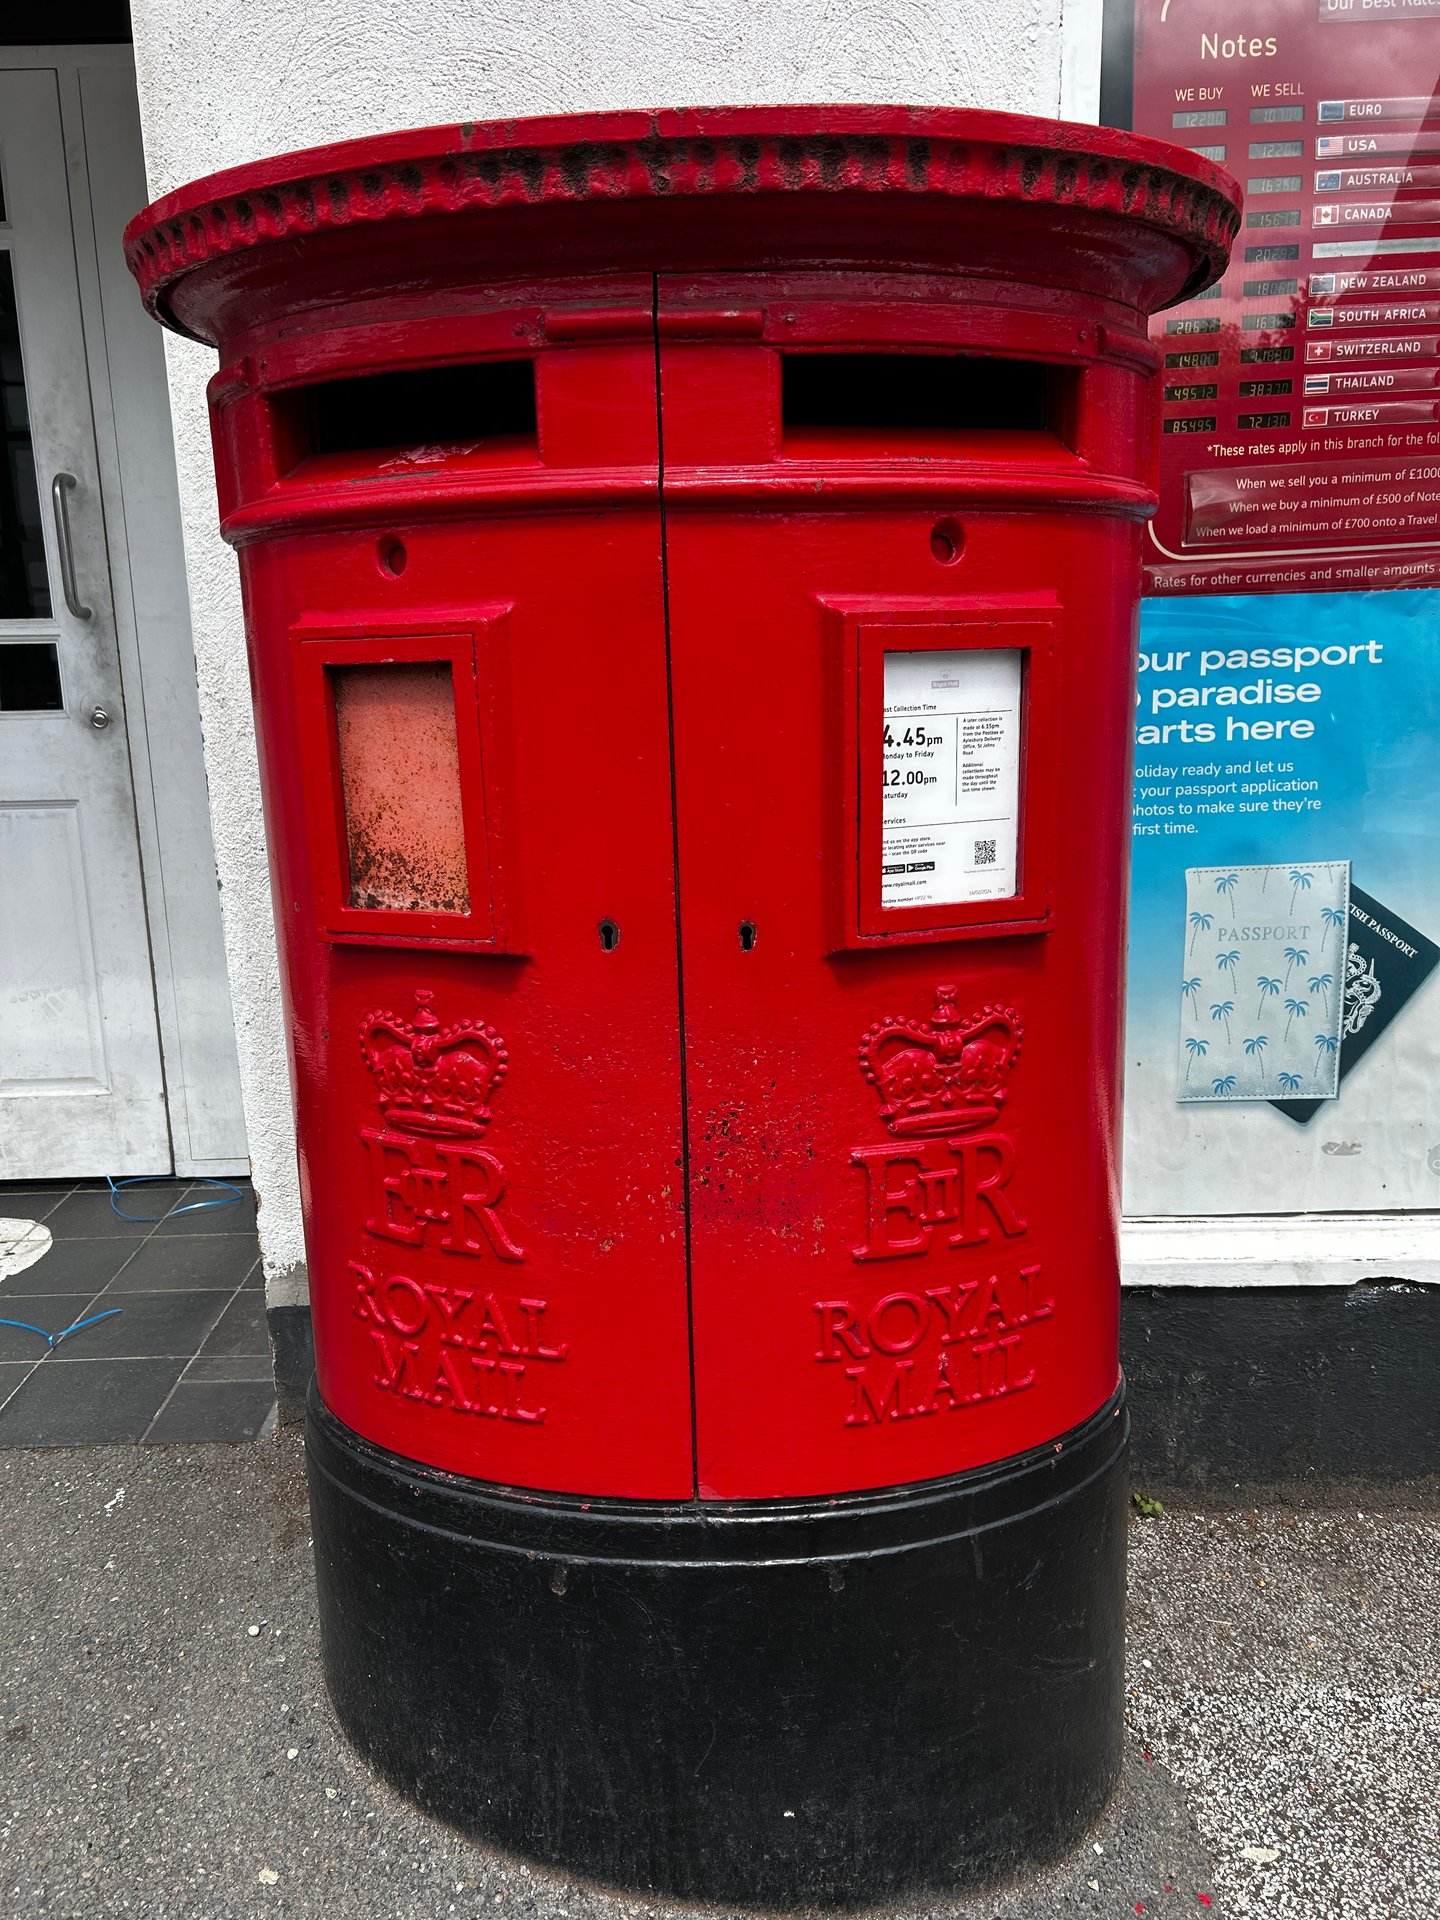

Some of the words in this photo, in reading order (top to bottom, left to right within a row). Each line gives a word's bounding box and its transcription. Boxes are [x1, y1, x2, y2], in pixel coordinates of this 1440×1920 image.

[1200, 33, 1278, 60] Notes
[1174, 88, 1195, 102] WE
[1199, 86, 1224, 100] BUY
[1250, 84, 1271, 97] WE
[1274, 82, 1305, 96] SELL
[1349, 103, 1382, 116] EURO
[1348, 139, 1378, 151] USA
[1346, 172, 1414, 186] AUSTRALIA
[1344, 207, 1393, 220] CANADA
[1340, 277, 1368, 289] NEW
[1372, 274, 1427, 288] ZEALAND
[1338, 310, 1380, 323] SOUTH
[1384, 308, 1427, 321] AFRICA
[1336, 341, 1421, 356] SWITZERLAND
[1335, 375, 1395, 389] THAILAND
[1334, 409, 1380, 422] TURKEY
[1248, 443, 1275, 455] rates
[1278, 440, 1307, 455] apply
[1310, 438, 1320, 451] in
[1324, 438, 1344, 450] this
[1347, 435, 1384, 449] branch
[1387, 434, 1403, 446] for
[1405, 433, 1424, 445] the
[1236, 478, 1266, 490] When
[1269, 478, 1285, 488] we
[1288, 475, 1306, 487] sell
[1308, 476, 1328, 488] you
[1331, 475, 1338, 484] a
[1341, 472, 1392, 483] minimum
[1395, 469, 1407, 480] of
[1229, 501, 1259, 513] When
[1262, 502, 1277, 511] we
[1280, 500, 1299, 512] buy
[1301, 500, 1308, 509] a
[1310, 497, 1360, 508] minimum
[1362, 494, 1374, 505] of
[1376, 493, 1401, 505] £500
[1403, 492, 1415, 503] of
[1196, 526, 1226, 537] When
[1228, 527, 1244, 535] we
[1246, 523, 1268, 534] load
[1270, 525, 1277, 533] a
[1279, 521, 1329, 533] minimum
[1331, 519, 1343, 530] of
[1344, 518, 1370, 529] £700
[1372, 517, 1396, 528] onto
[1399, 517, 1405, 526] a
[1407, 513, 1438, 525] Travel
[1154, 576, 1187, 588] Rates
[1190, 574, 1207, 586] for
[1210, 573, 1242, 586] other
[1245, 569, 1306, 583] currencies
[1310, 568, 1332, 580] and
[1335, 565, 1380, 579] smaller
[1383, 562, 1435, 577] amounts
[1200, 640, 1384, 676] passport
[1152, 679, 1322, 714] paradise
[893, 704, 921, 712] Collection
[922, 703, 937, 711] Time
[883, 724, 943, 747] 4.45pm
[1226, 716, 1315, 742] here
[914, 750, 935, 759] Friday
[883, 769, 937, 787] 12.00pm
[1135, 763, 1178, 779] oliday
[1182, 761, 1222, 778] ready
[1225, 761, 1251, 775] and
[1255, 760, 1274, 773] let
[1277, 761, 1294, 773] us
[1140, 785, 1171, 800] your
[1175, 781, 1238, 798] passport
[1241, 778, 1319, 796] application
[1178, 803, 1193, 815] to
[1196, 800, 1235, 815] make
[1238, 801, 1269, 813] sure
[1272, 797, 1322, 813] they're
[1132, 822, 1160, 836] first
[1164, 821, 1199, 835] time.
[1217, 925, 1311, 942] PASSPORT
[1366, 918, 1419, 959] PASSPORT
[348, 1259, 570, 1361] ROYAL
[812, 1264, 1055, 1362] ROYAL
[370, 1329, 548, 1424] MAIL
[843, 1334, 1036, 1426] MAIL
